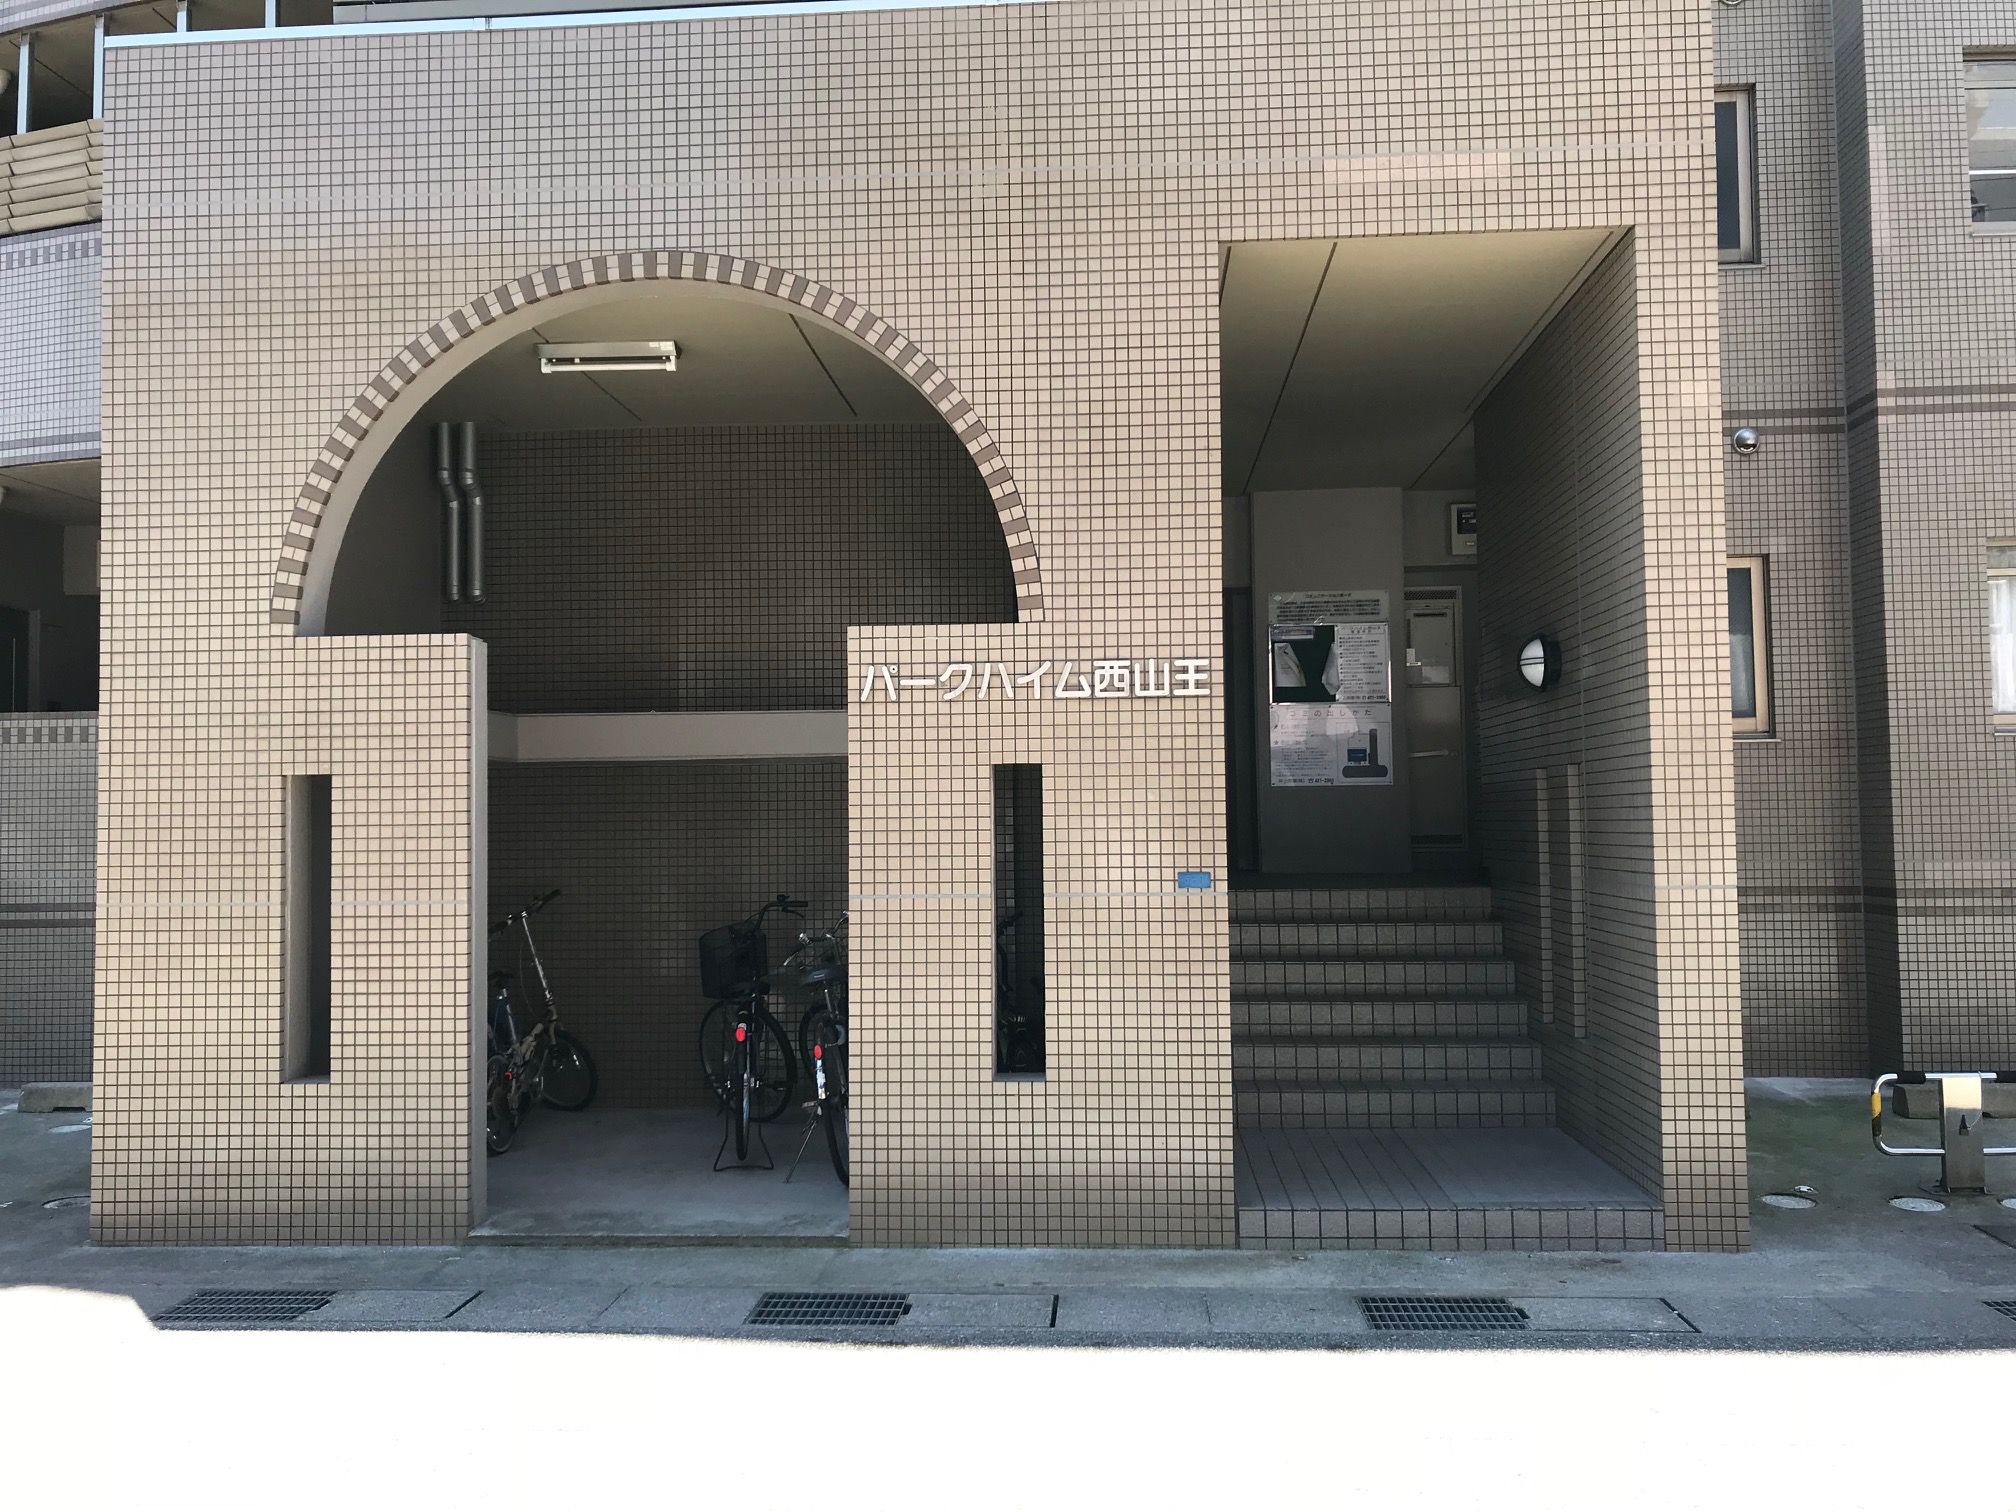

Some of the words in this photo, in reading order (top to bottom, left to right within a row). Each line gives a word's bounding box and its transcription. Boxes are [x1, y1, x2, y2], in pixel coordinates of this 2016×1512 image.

[861, 658, 1211, 702] パークハイム西山王
